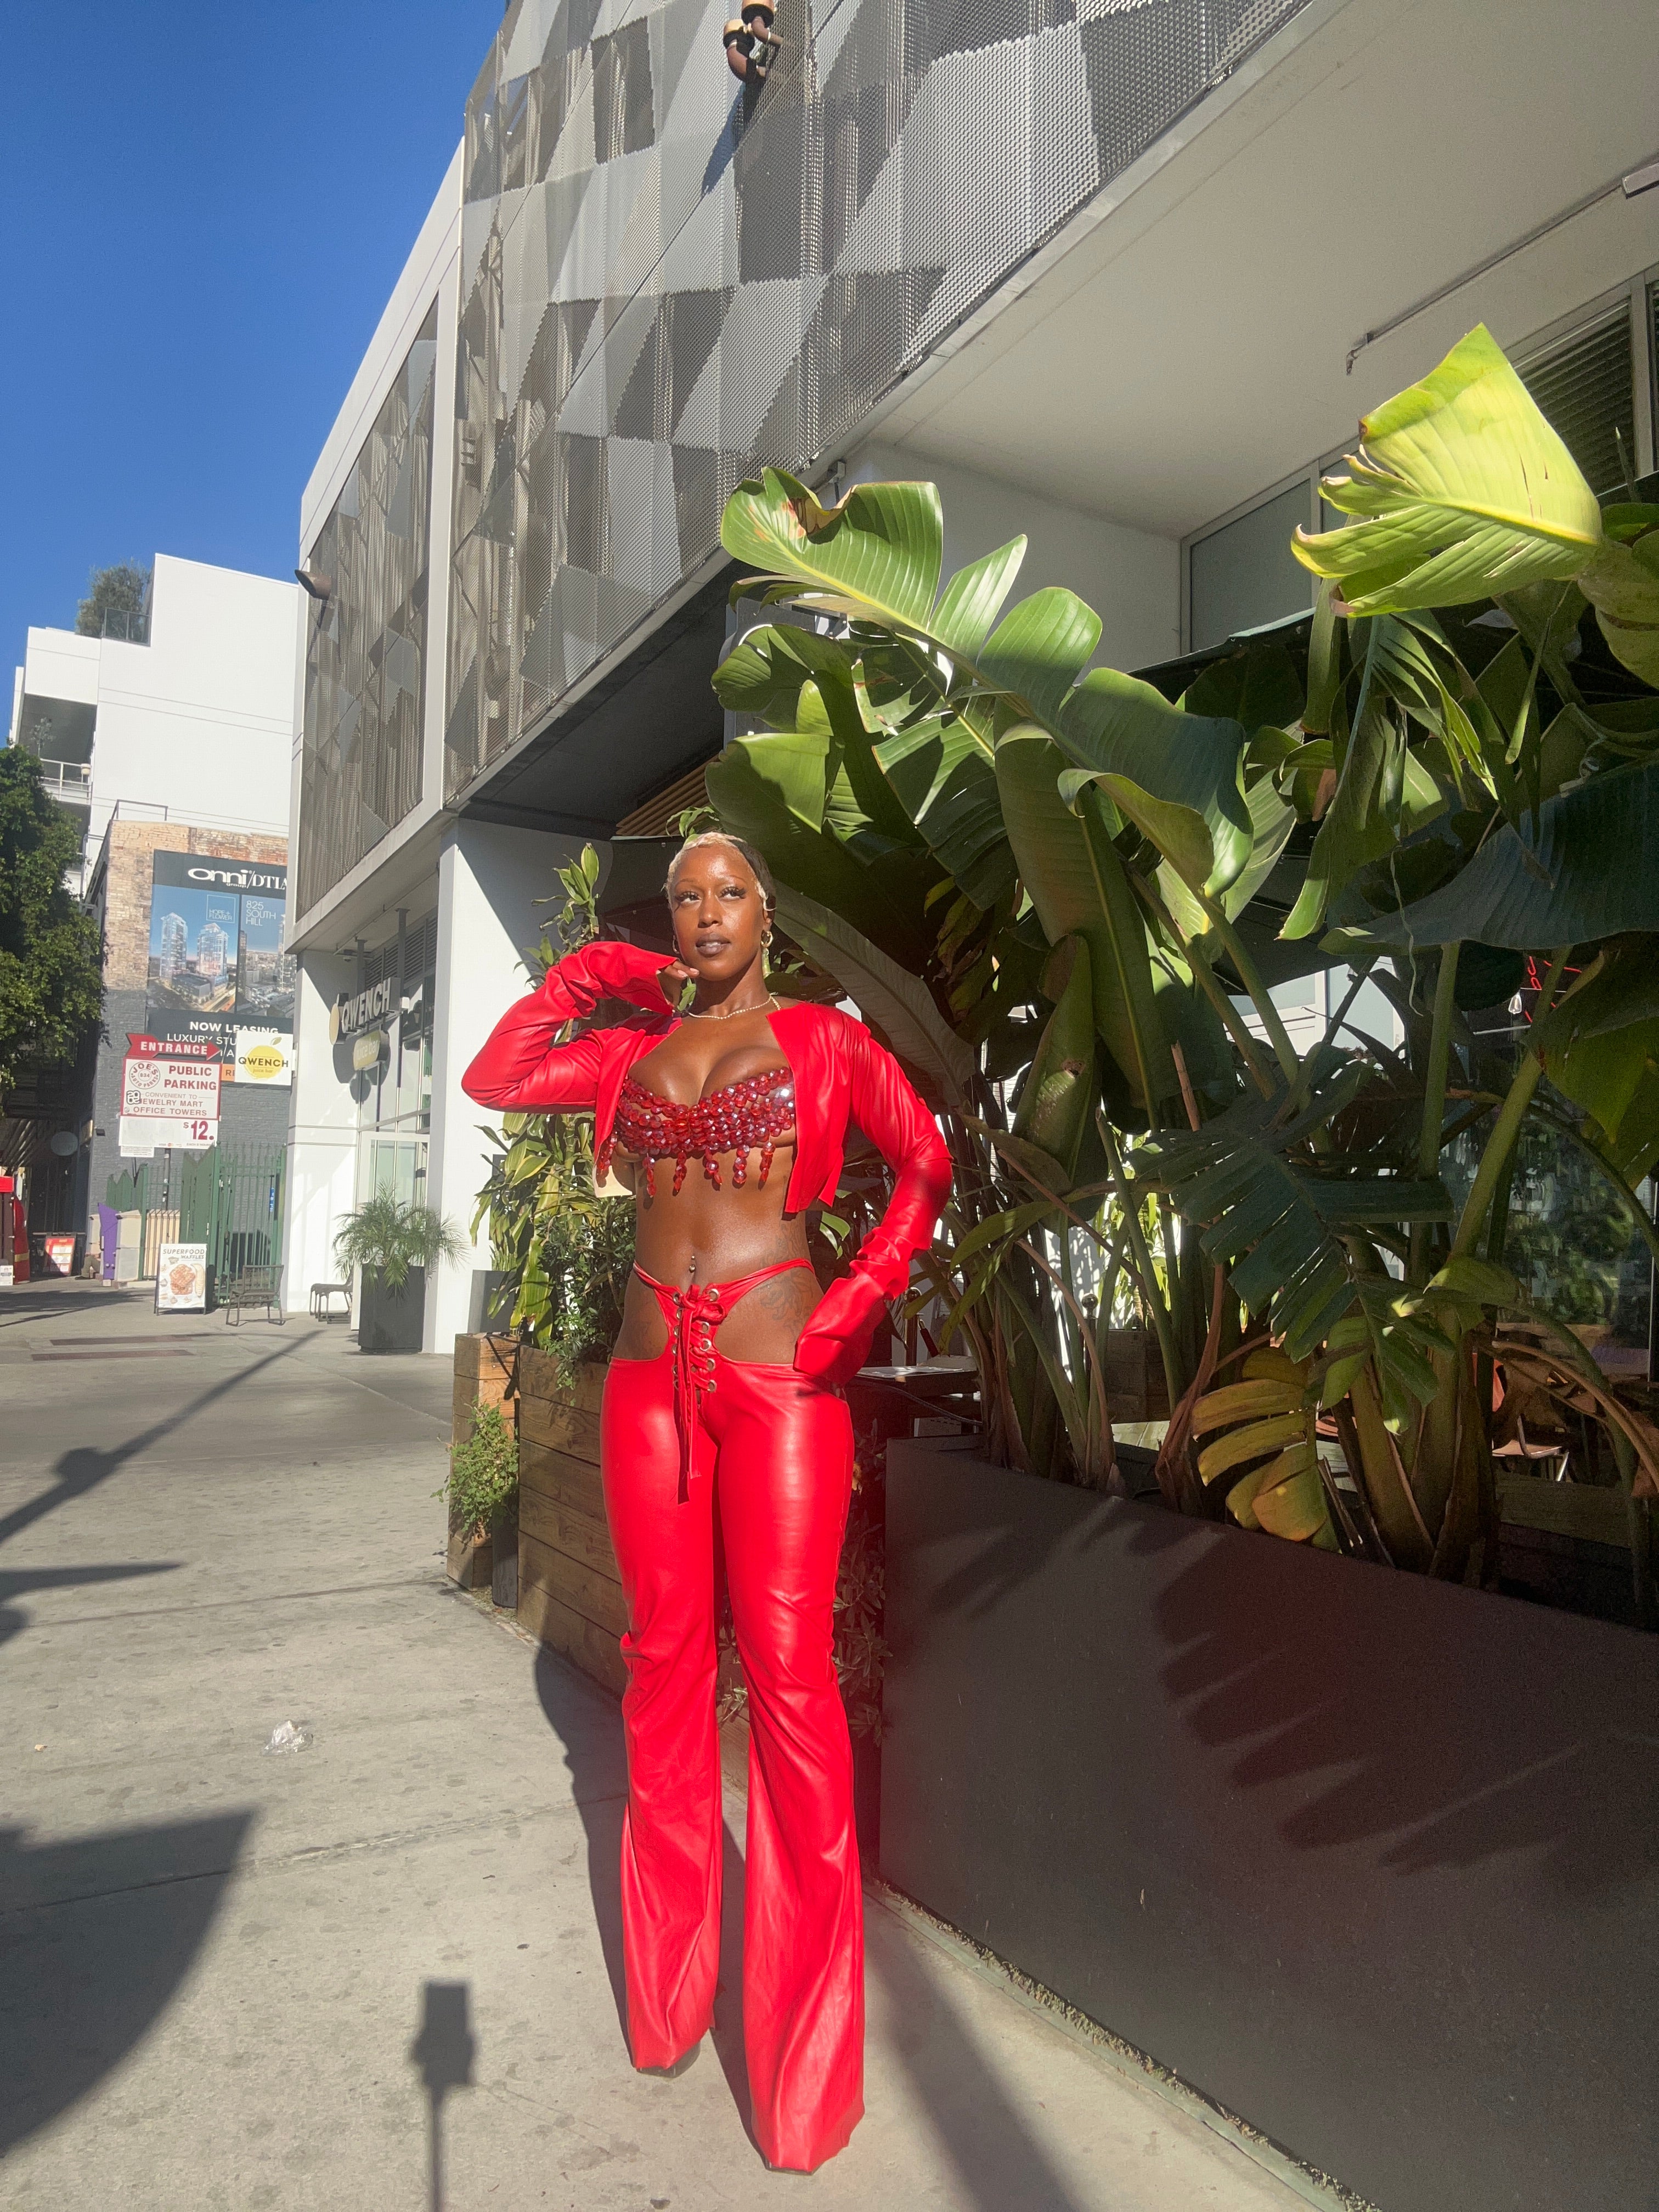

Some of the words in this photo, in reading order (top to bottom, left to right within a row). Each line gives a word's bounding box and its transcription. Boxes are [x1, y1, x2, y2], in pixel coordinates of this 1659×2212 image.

[246, 900, 264, 910] 825
[246, 910, 276, 919] SOUTH
[246, 917, 263, 926] HILL
[342, 977, 391, 1034] QWENCH
[190, 1022, 222, 1032] NOW
[140, 1041, 207, 1055] ENTRANCE
[238, 1057, 289, 1068] QWENCH
[133, 1063, 159, 1075] JOE'S
[169, 1065, 212, 1076] PUBLIC
[164, 1079, 216, 1090] PARKING
[133, 1106, 166, 1114] OFFICE
